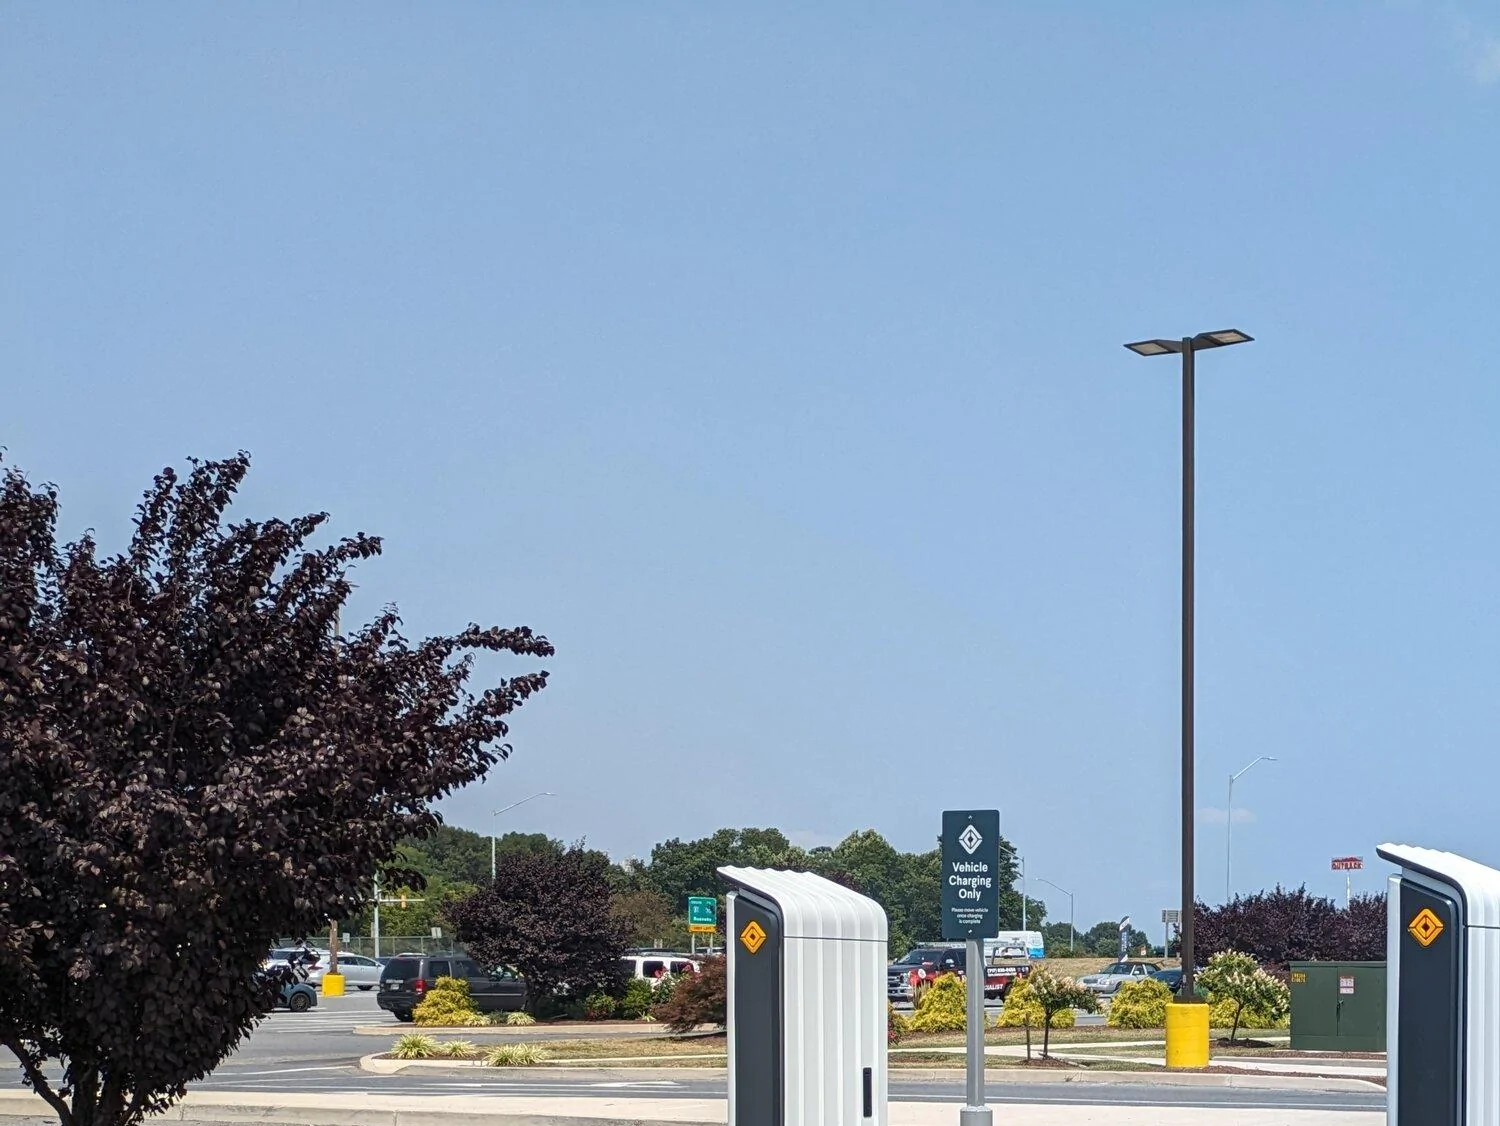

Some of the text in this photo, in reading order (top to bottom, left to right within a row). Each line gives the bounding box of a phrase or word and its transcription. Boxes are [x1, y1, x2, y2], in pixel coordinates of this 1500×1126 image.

[952, 862, 988, 872] Vehicle
[948, 875, 992, 888] Charging
[958, 888, 982, 901] Only
